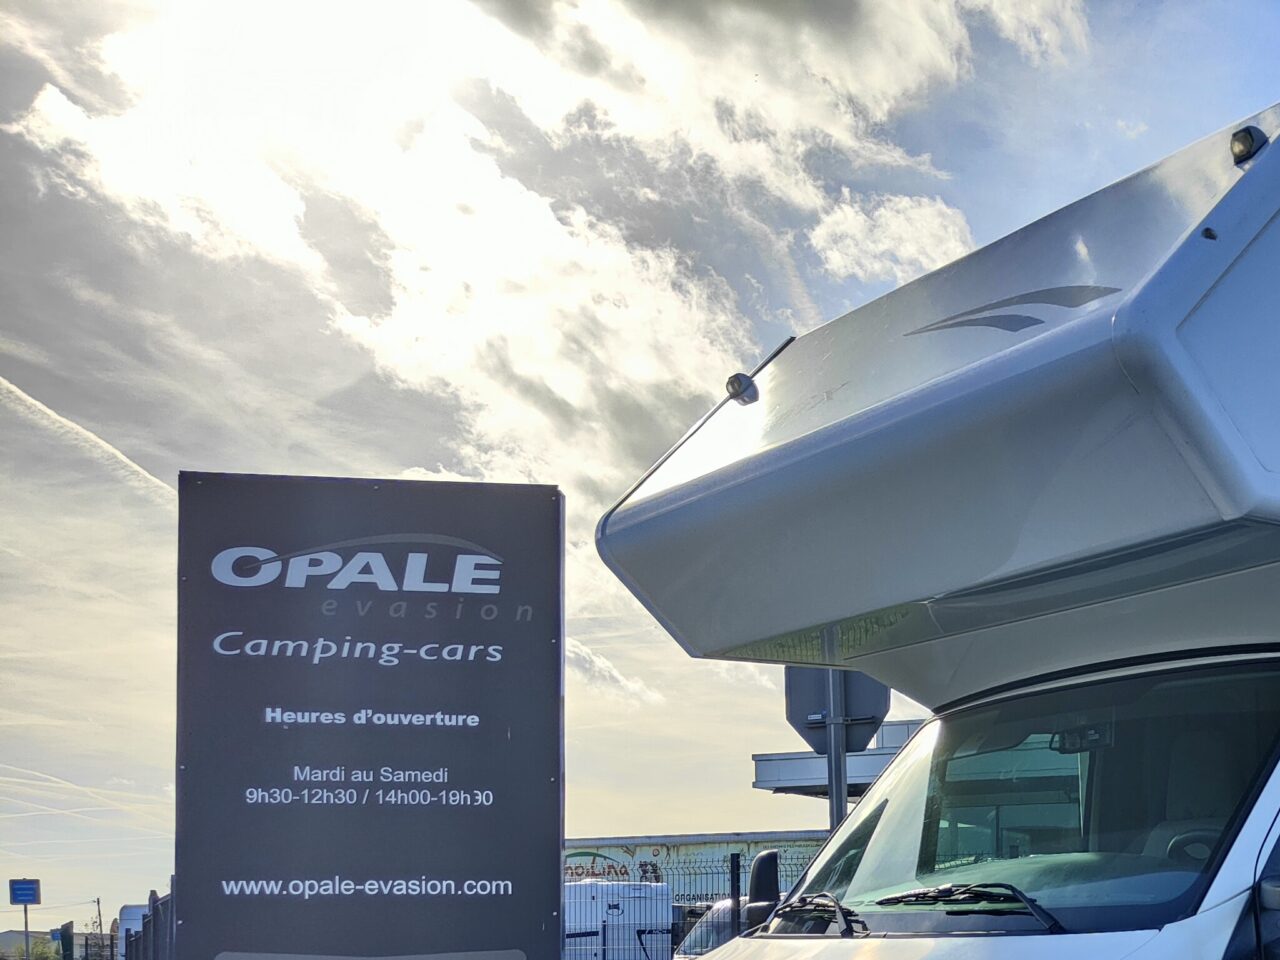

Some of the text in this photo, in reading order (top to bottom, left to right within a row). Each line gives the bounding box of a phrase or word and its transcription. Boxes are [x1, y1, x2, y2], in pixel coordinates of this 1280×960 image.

[211, 546, 502, 594] OPALE
[321, 597, 533, 622] evasion
[212, 631, 503, 666] Camping-cars
[265, 707, 480, 727] Heures d'ouverture
[294, 765, 448, 783] Mardi au Samedi
[246, 788, 494, 806] 9h30-12h30 / 14h00-19h30
[221, 875, 513, 899] www.opale-evasion.com
